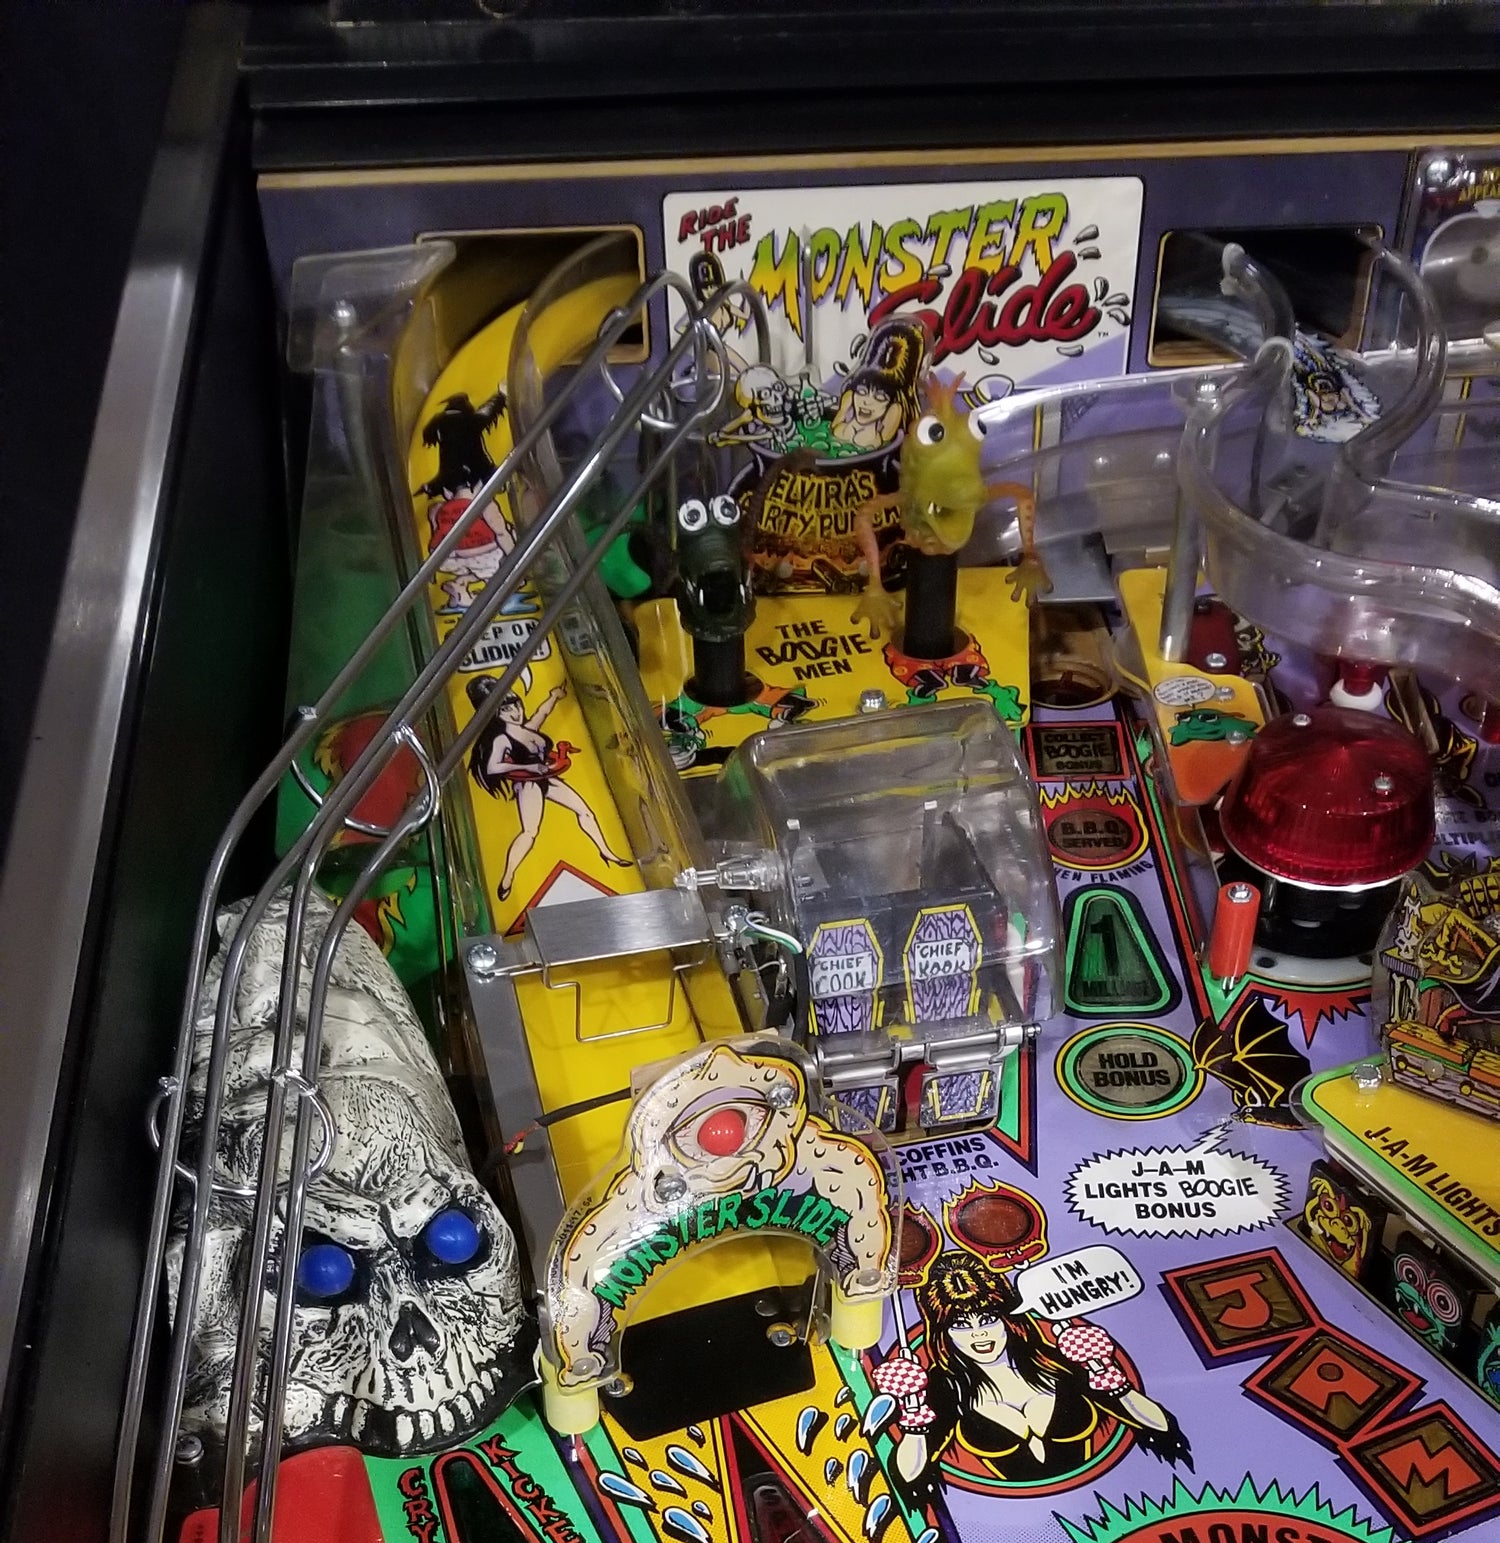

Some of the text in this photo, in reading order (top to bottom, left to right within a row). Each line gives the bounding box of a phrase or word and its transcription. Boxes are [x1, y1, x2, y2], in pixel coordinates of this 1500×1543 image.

[678, 196, 740, 244] RIDE
[700, 213, 752, 253] THE
[740, 193, 1068, 341] MONSTER
[867, 250, 1102, 366] Slide
[769, 471, 876, 512] ELVIRA'S
[775, 620, 827, 640] THE
[462, 641, 545, 667] SLIDIN!
[755, 634, 872, 666] BOOGIE
[792, 659, 852, 680] MEN
[1045, 743, 1112, 758] BOOGIE
[1090, 860, 1154, 883] FLAMING
[919, 942, 963, 958] CHIEF
[1090, 914, 1120, 978] 1
[820, 956, 864, 972] CHIEF
[918, 960, 966, 978] KOOK
[816, 971, 867, 996] COOK
[1099, 1051, 1158, 1070] HOLD
[1094, 1069, 1171, 1088] BONUS
[896, 1137, 986, 1166] COFFINS
[931, 1154, 999, 1177] B.B.Q.
[1085, 1177, 1259, 1199] LIGHTS BOOGIE
[1364, 1126, 1500, 1236] J-A-M LIGHTS
[1135, 1202, 1216, 1219] BONUS
[592, 1187, 852, 1310] MONSTER SLIDE
[1051, 1259, 1089, 1284] I'M
[1038, 1271, 1135, 1315] HUNGRY!
